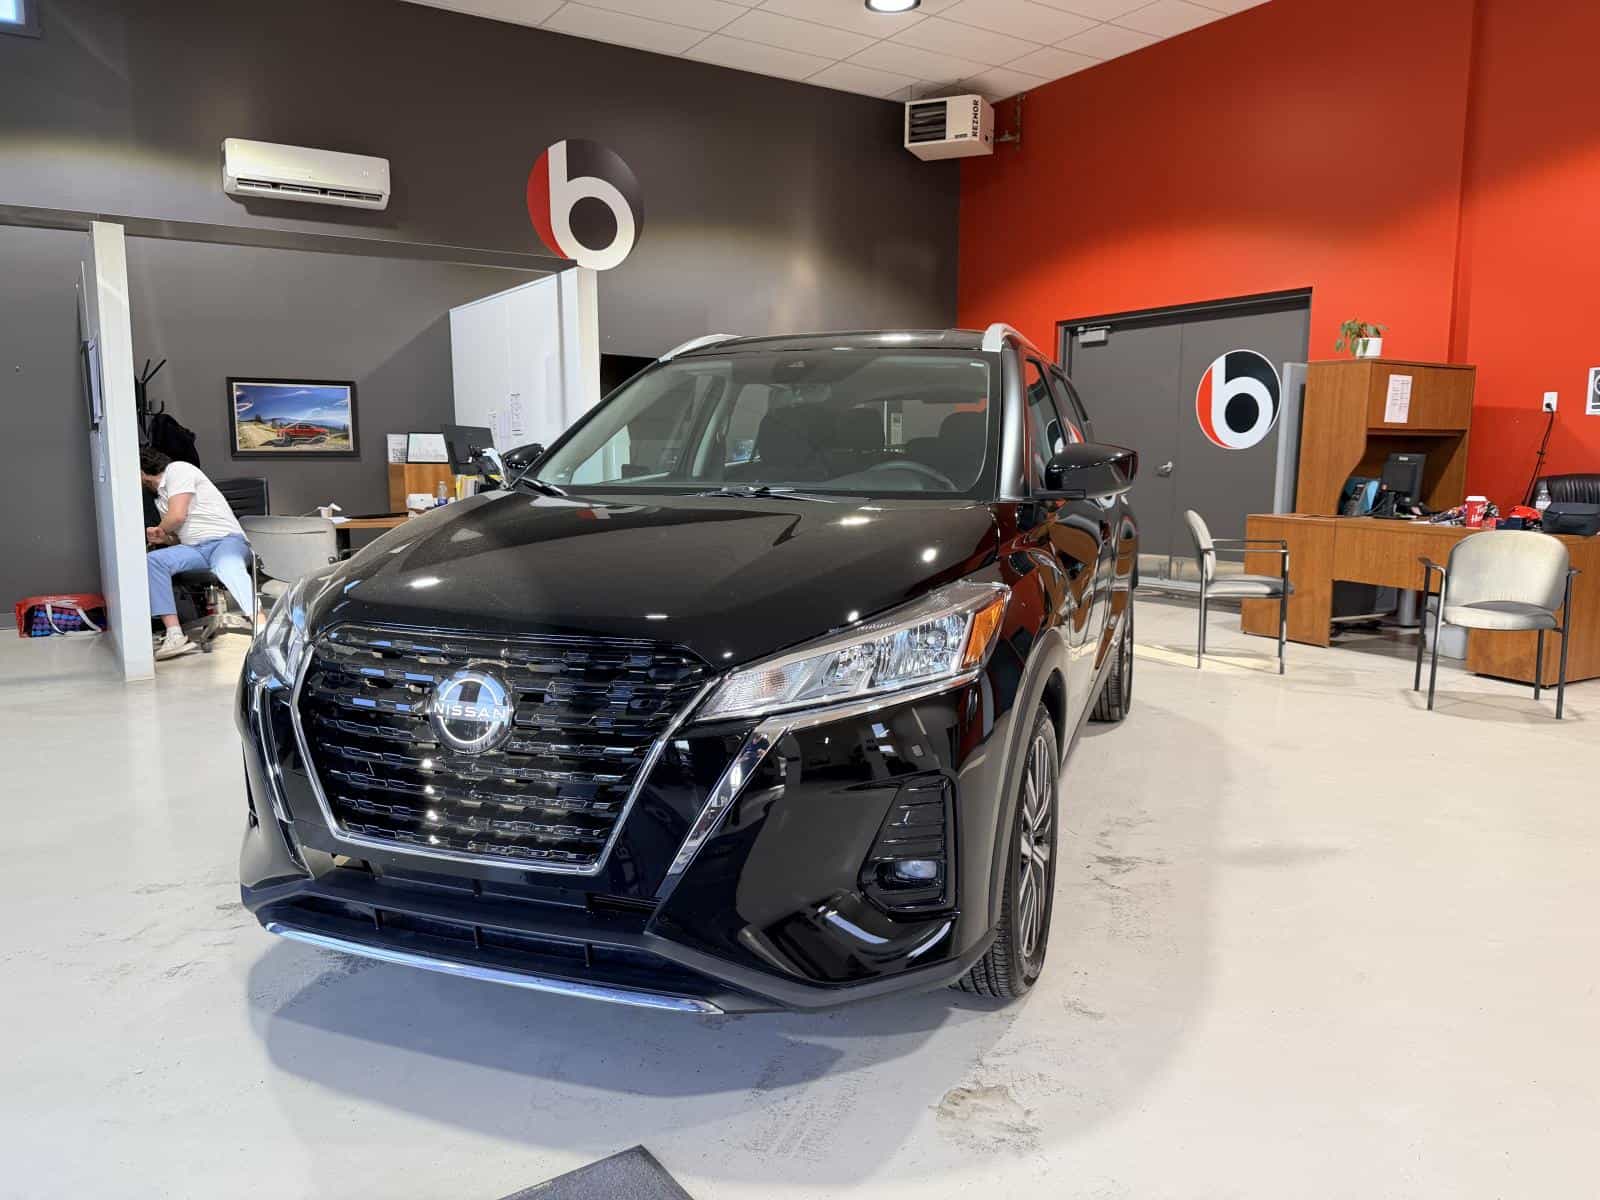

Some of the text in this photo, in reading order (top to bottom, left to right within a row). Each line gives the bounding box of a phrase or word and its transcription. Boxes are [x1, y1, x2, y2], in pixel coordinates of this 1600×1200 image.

[548, 139, 636, 271] b
[1211, 354, 1274, 449] b
[433, 702, 505, 718] NISSAN
